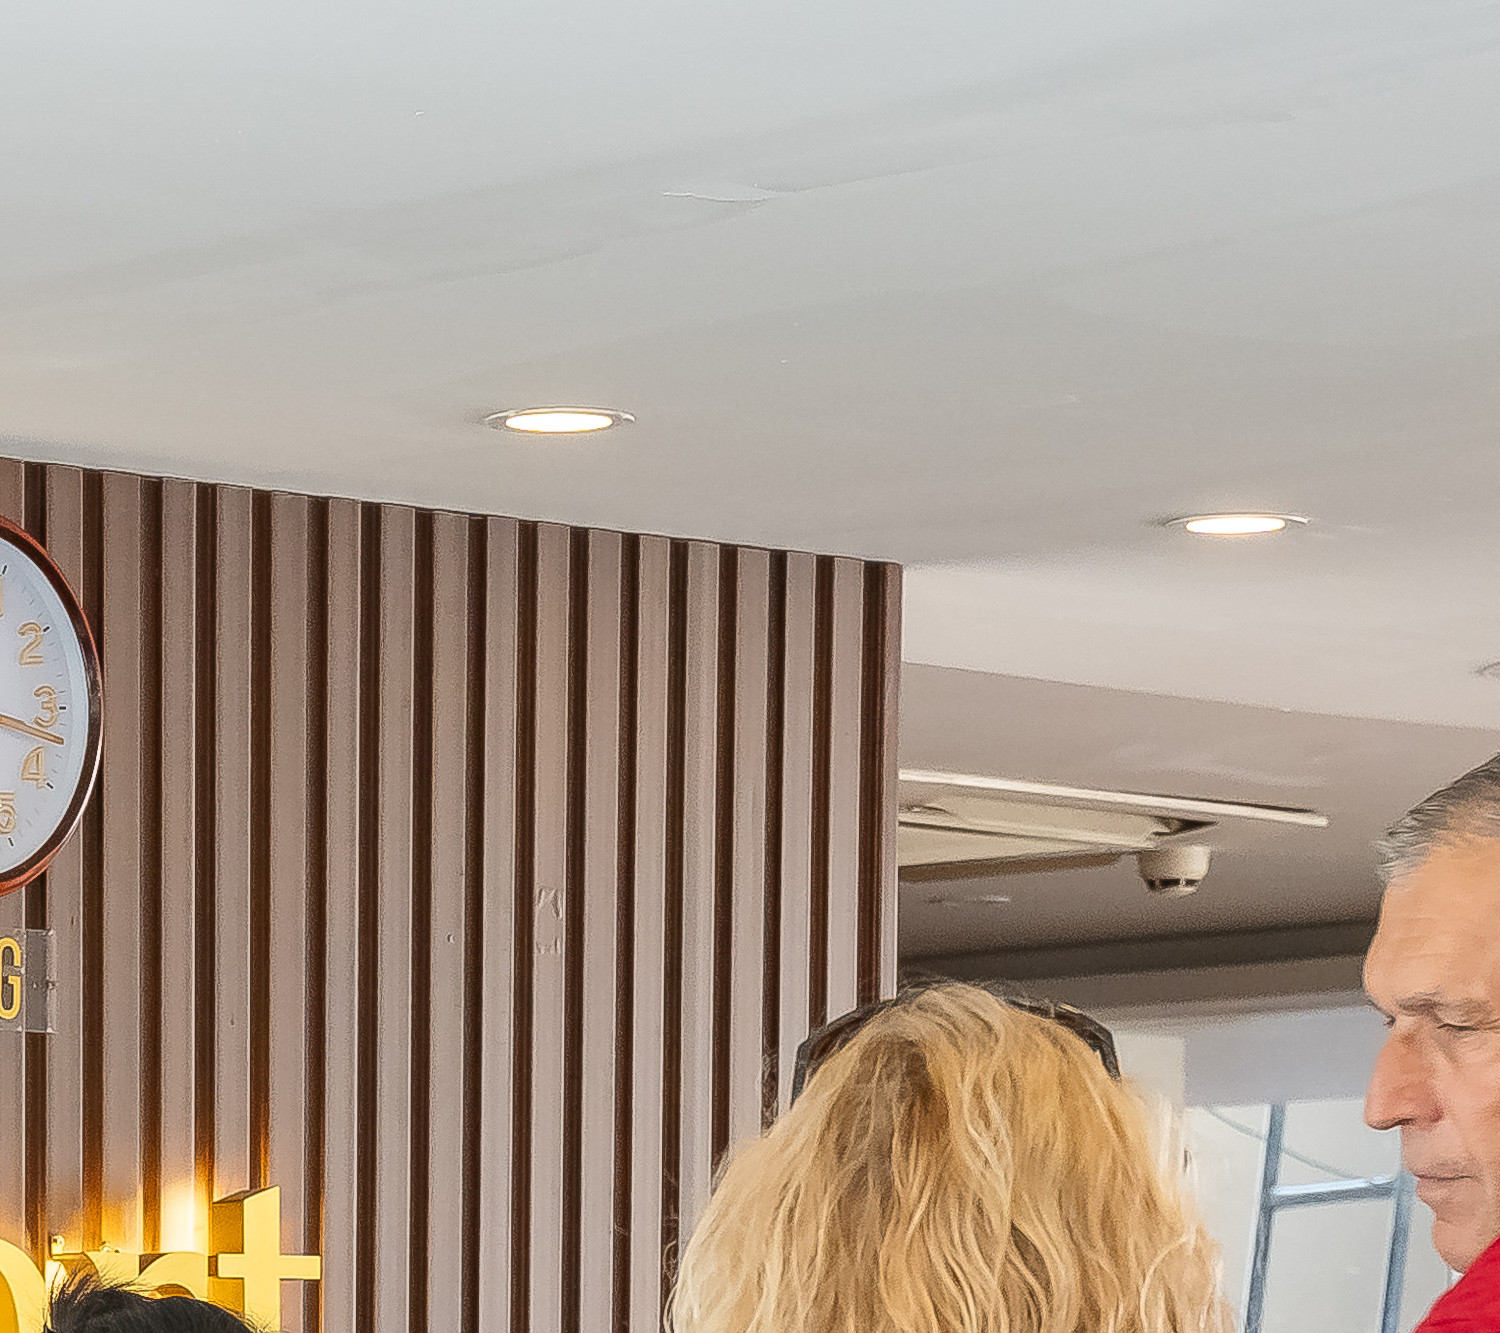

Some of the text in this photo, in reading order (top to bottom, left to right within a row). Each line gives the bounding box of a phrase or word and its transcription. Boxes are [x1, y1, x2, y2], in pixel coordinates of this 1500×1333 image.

[17, 622, 44, 666] 2
[33, 685, 58, 728] 3
[20, 746, 46, 788] 4
